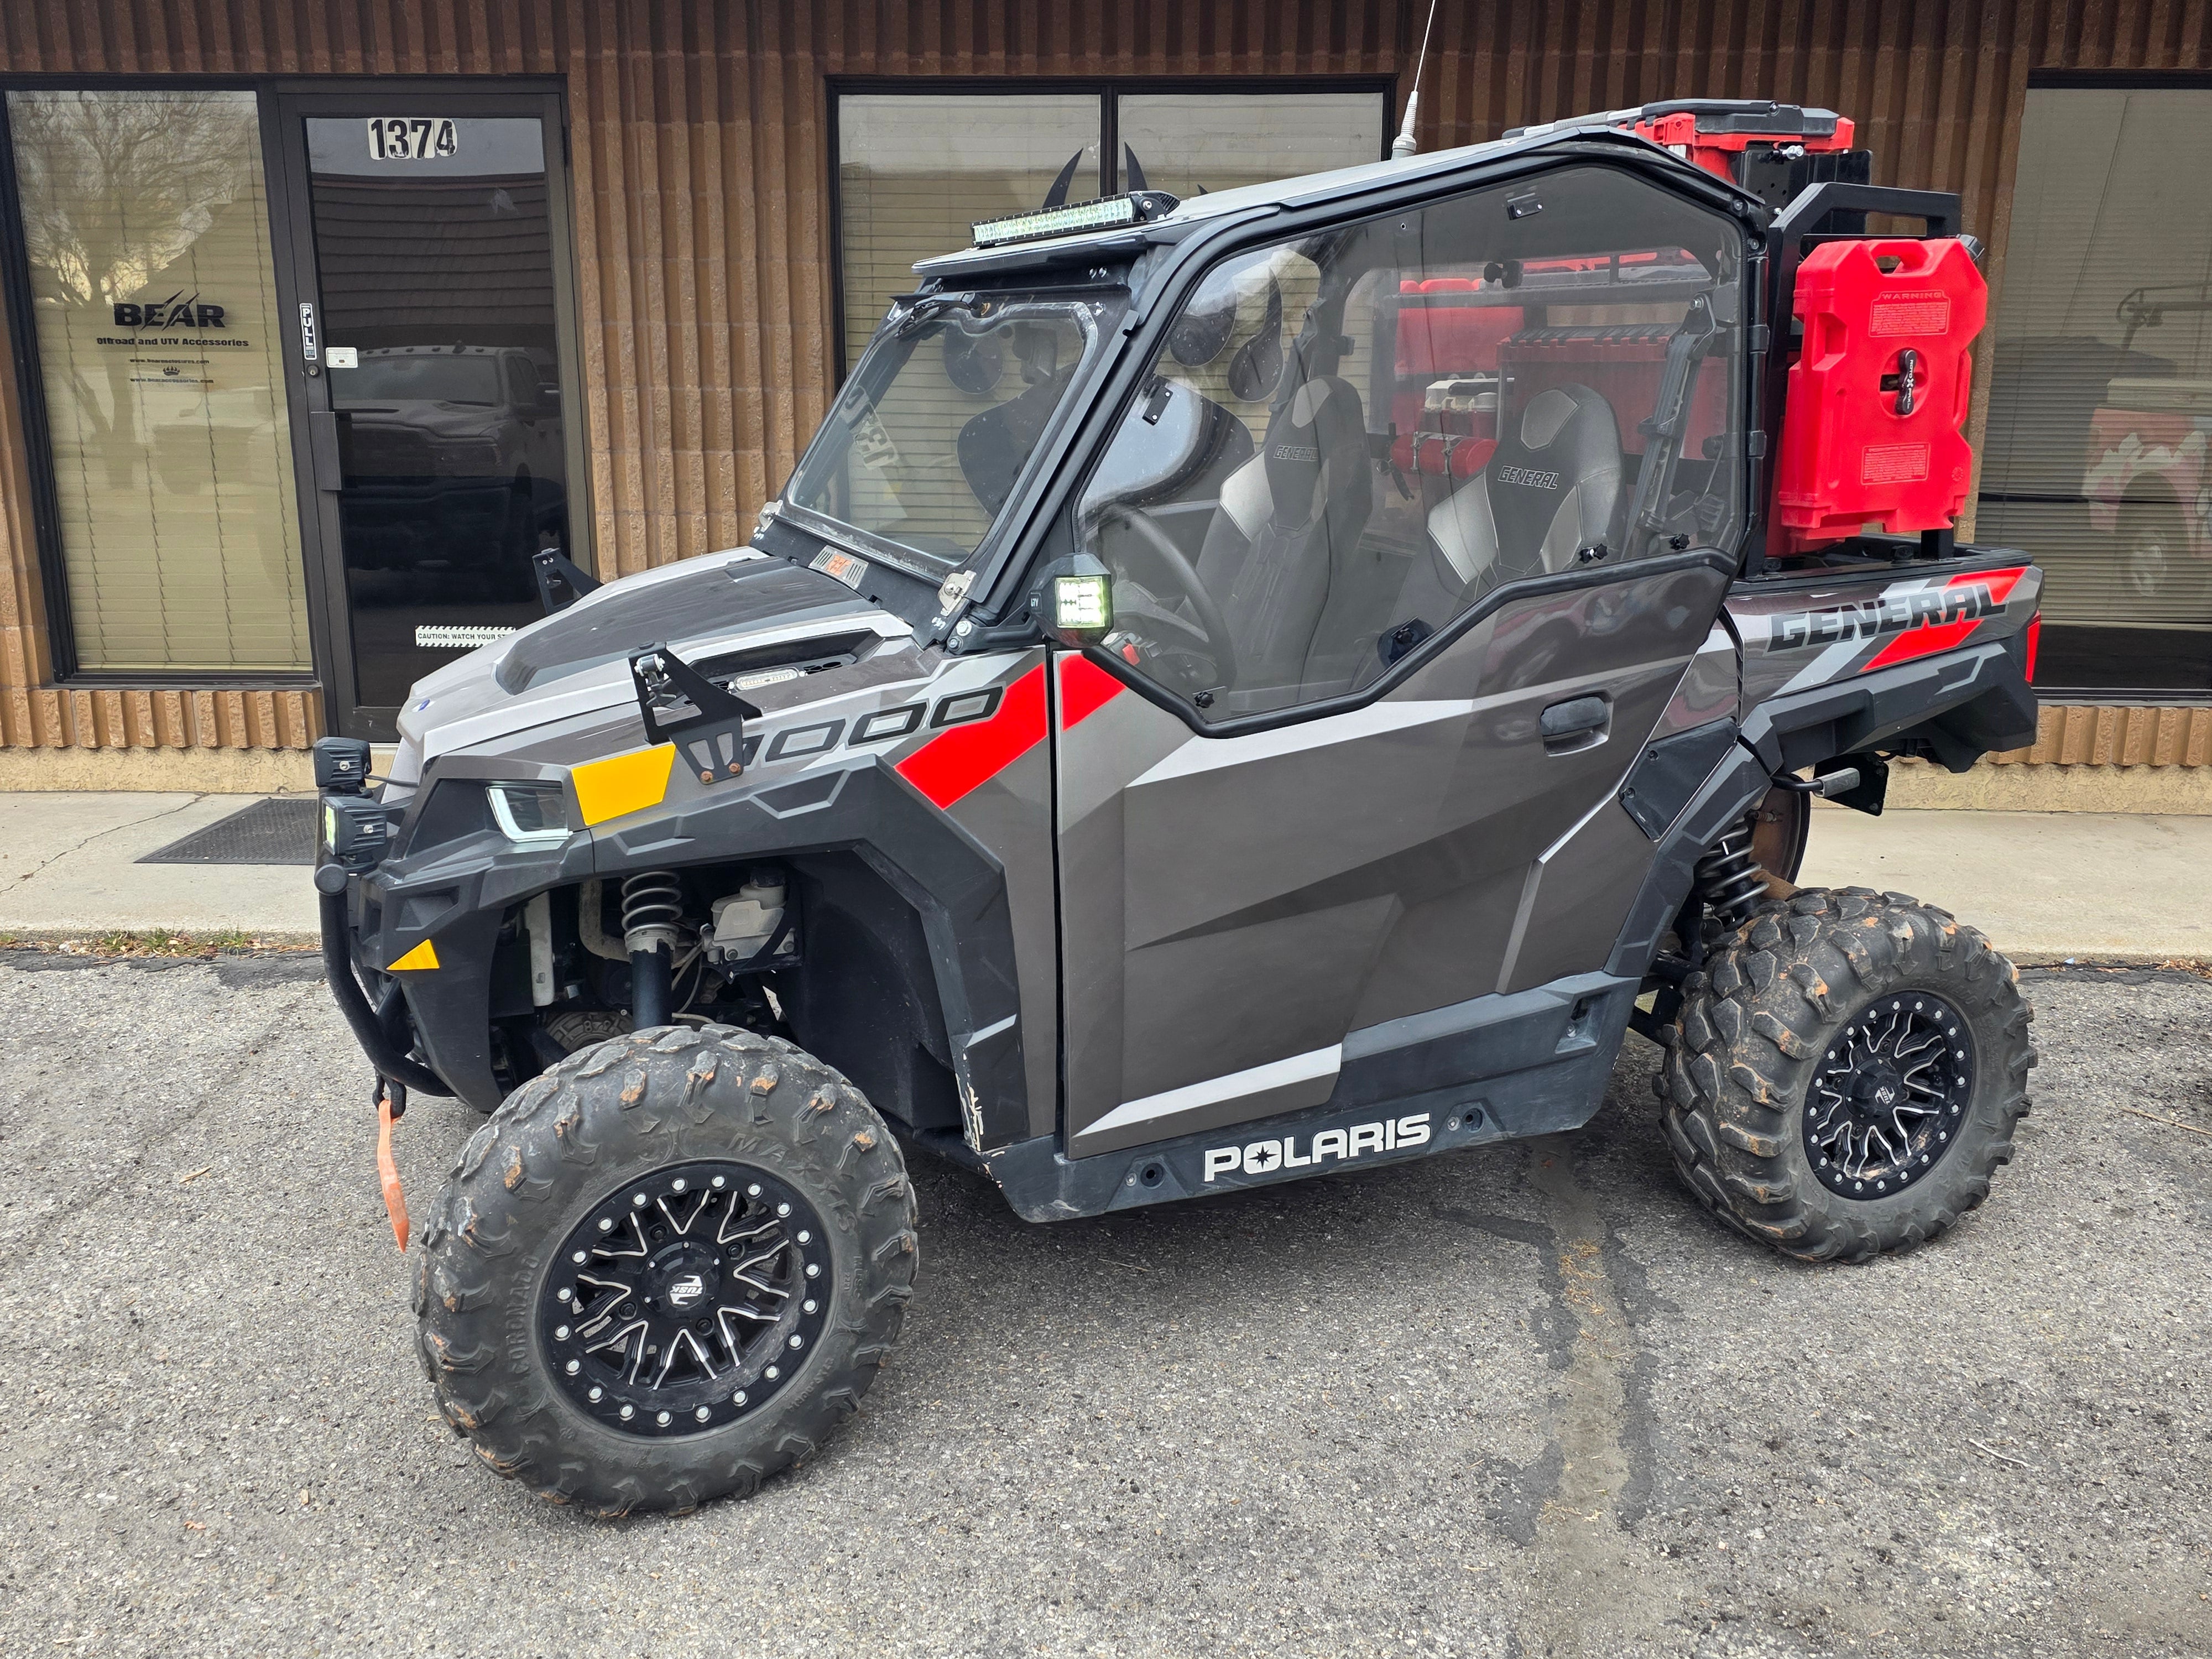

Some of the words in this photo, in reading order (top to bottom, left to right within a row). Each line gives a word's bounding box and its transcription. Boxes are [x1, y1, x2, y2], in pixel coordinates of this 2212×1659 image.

[371, 118, 456, 159] 1374
[114, 289, 226, 331] BEAR
[302, 308, 314, 346] PULL
[182, 338, 249, 347] Accessories
[1274, 445, 1318, 461] GENERAL
[1498, 465, 1558, 489] GENERAL
[1767, 583, 2007, 651] GENERAL
[1203, 1112, 1431, 1182] POLARIS
